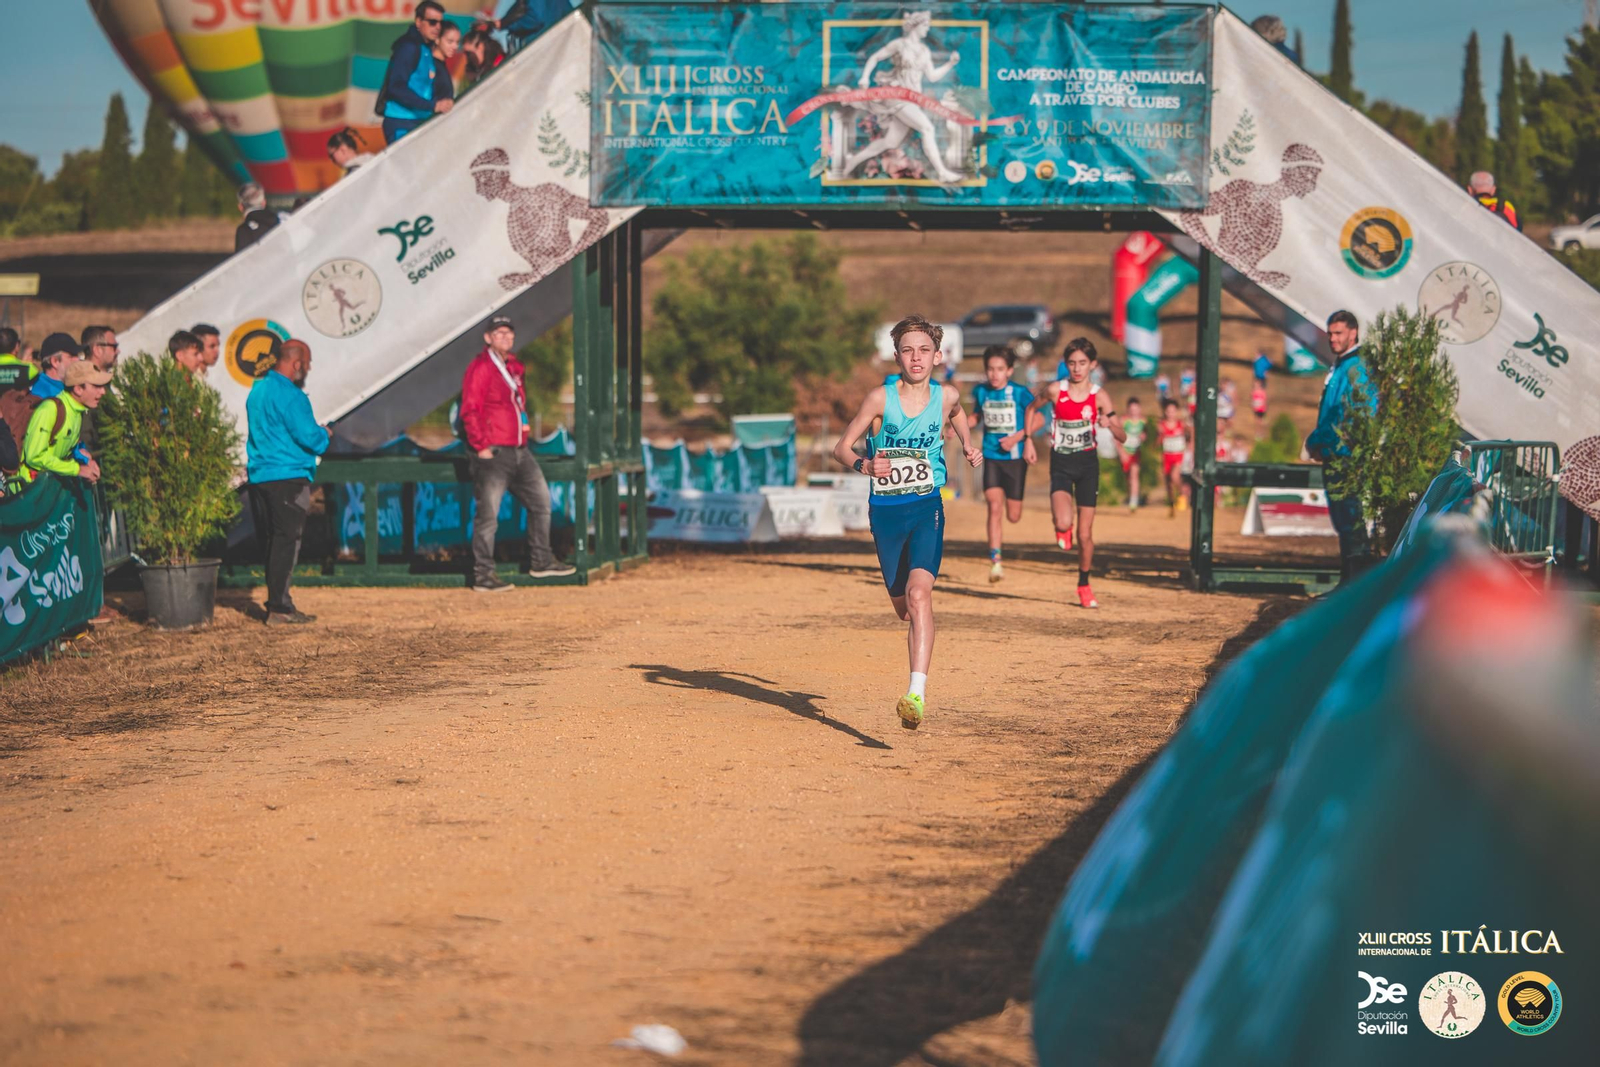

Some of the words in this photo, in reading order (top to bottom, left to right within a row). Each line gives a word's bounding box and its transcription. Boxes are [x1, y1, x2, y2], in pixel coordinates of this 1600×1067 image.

[607, 64, 692, 95] XLIII
[691, 66, 766, 84] CROSS
[996, 67, 1097, 82] CAMPEONATO
[1098, 69, 1118, 83] DE
[1120, 69, 1206, 84] ANDALUCÍA
[692, 85, 789, 95] INTERNACIONAL
[1065, 81, 1083, 94] DE
[1083, 81, 1138, 95] CAMPO
[1028, 93, 1042, 106] A
[1043, 92, 1098, 107] TRAVÉS
[1097, 94, 1125, 108] POR
[1127, 95, 1181, 109] CLUBES
[1017, 120, 1032, 135] Y
[1035, 120, 1049, 137] 9
[1052, 120, 1077, 137] DE
[1081, 120, 1197, 140] NOVIEMBRE
[604, 136, 695, 149] INTERNATIONAL
[697, 136, 732, 147] CROSS
[732, 135, 788, 147] COUNTRY
[407, 247, 456, 285] Sevilla
[1504, 348, 1554, 387] Diputación
[1496, 358, 1546, 400] Sevilla
[1206, 387, 1216, 400] 2
[884, 432, 935, 449] nerja
